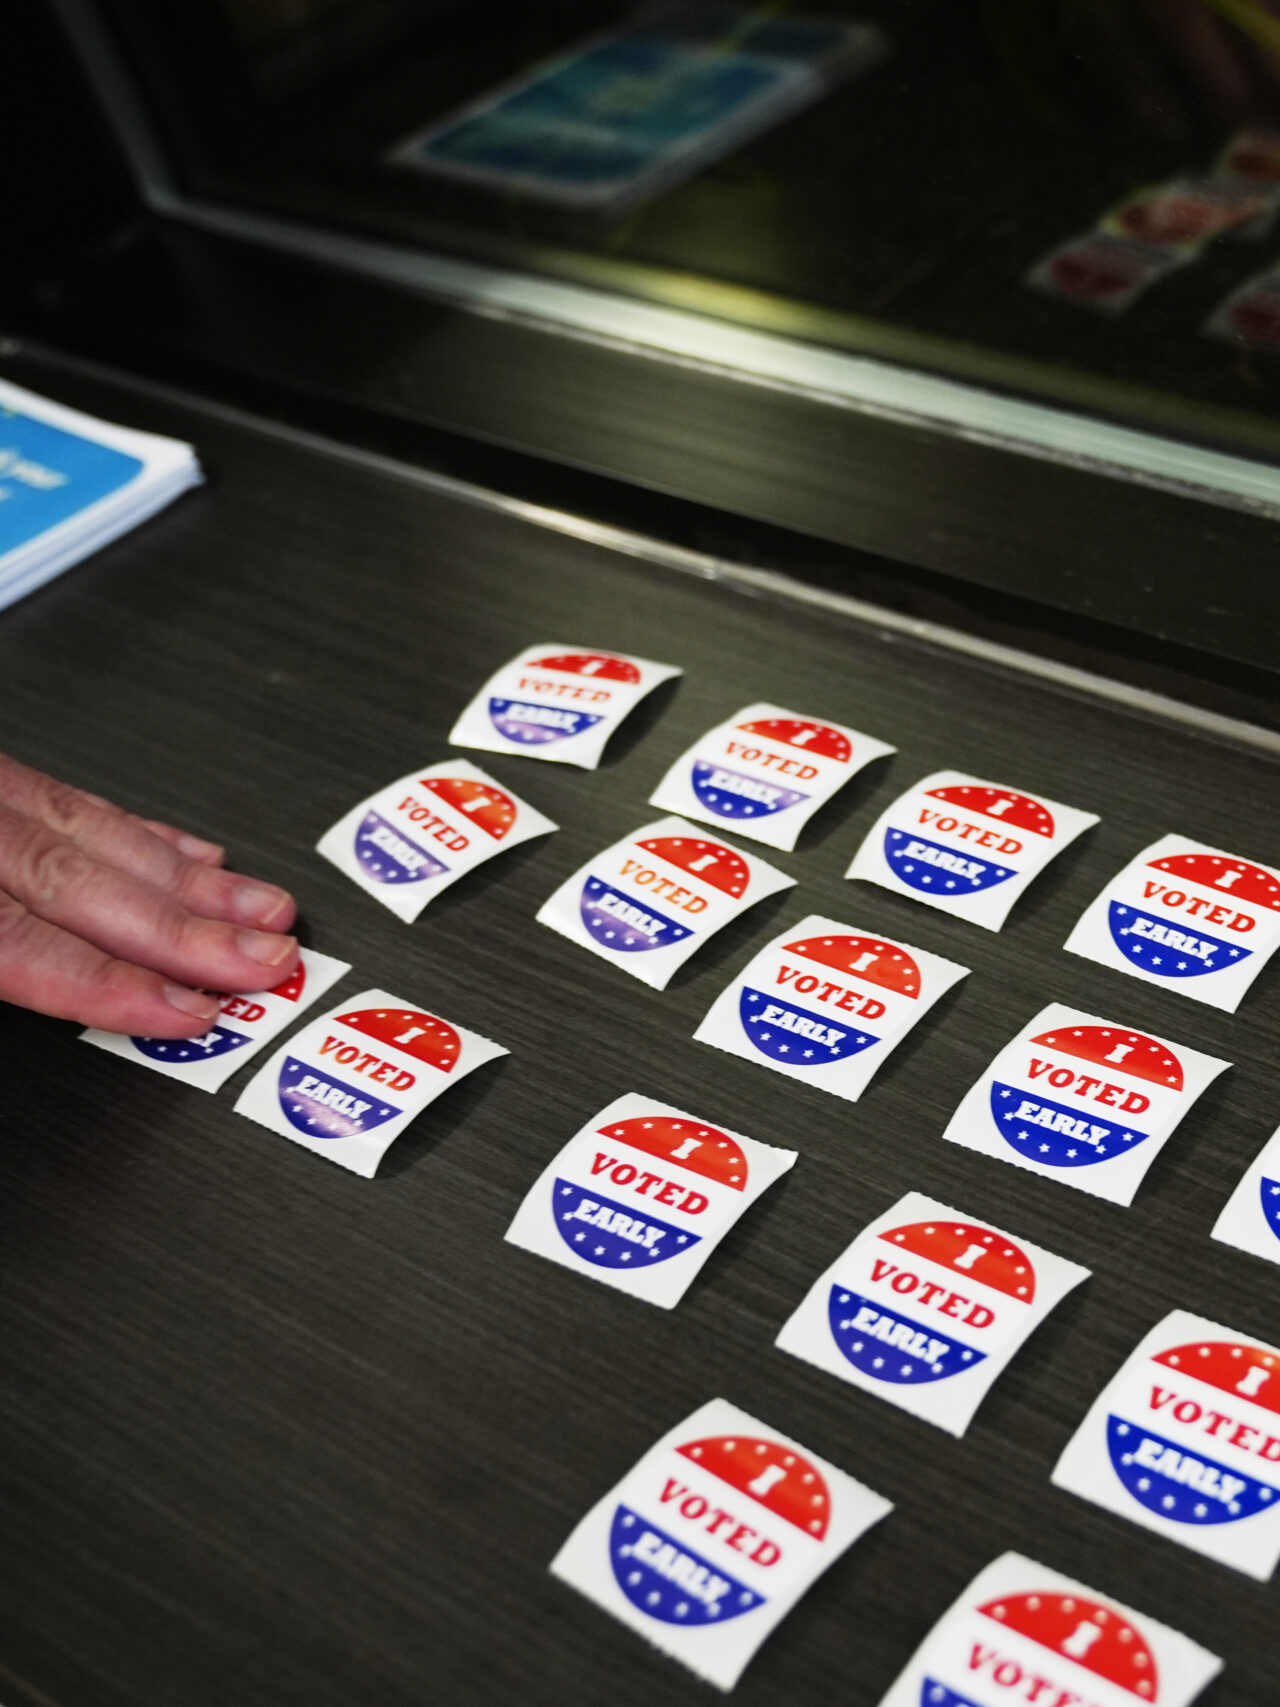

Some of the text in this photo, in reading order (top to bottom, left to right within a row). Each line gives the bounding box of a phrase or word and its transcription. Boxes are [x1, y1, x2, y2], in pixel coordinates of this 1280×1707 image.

[519, 678, 612, 702] VOTED
[790, 729, 817, 746] I
[726, 742, 818, 779] VOTED
[398, 797, 469, 851] VOTED
[461, 796, 492, 812] I
[986, 799, 1014, 816] I
[919, 809, 1022, 854] VOTED
[688, 854, 718, 872] I
[903, 841, 986, 879] EARLY
[1214, 870, 1243, 888] I
[620, 860, 708, 913] VOTED
[1144, 881, 1256, 932] VOTED
[599, 893, 667, 936] EARLY
[1129, 917, 1219, 959] EARLY
[848, 951, 879, 972] I
[776, 965, 886, 1019] VOTED
[393, 1026, 427, 1044] I
[760, 1004, 847, 1047] EARLY
[319, 1036, 416, 1091] VOTED
[1103, 1043, 1135, 1064] I
[296, 1075, 373, 1118] EARLY
[1028, 1059, 1150, 1114] VOTED
[1014, 1100, 1111, 1145] EARLY
[670, 1137, 703, 1160] I
[591, 1152, 709, 1215] VOTED
[573, 1199, 666, 1248] EARLY
[953, 1243, 987, 1270] I
[871, 1259, 995, 1328] VOTED
[850, 1306, 950, 1363] EARLY
[1236, 1366, 1270, 1397] I
[749, 1464, 787, 1496] I
[1134, 1438, 1246, 1502] EARLY
[660, 1478, 781, 1567] VOTED
[633, 1531, 731, 1603] EARLY
[1063, 1621, 1101, 1658] I
